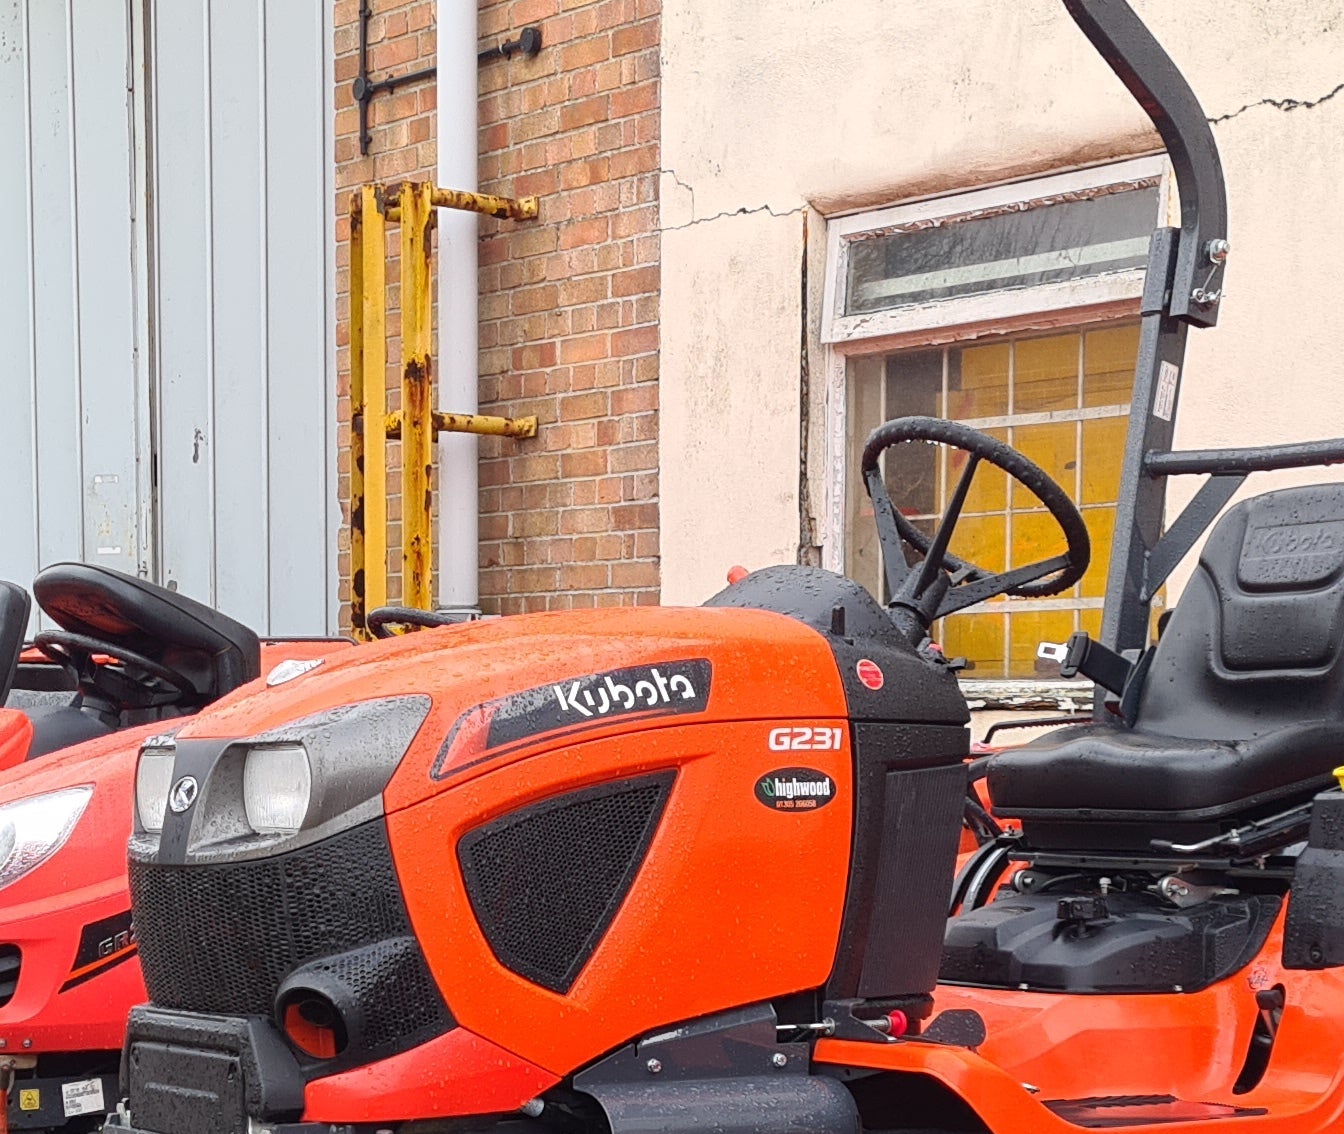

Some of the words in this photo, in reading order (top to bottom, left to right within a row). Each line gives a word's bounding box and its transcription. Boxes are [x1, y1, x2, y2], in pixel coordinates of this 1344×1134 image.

[553, 668, 696, 717] Kubota
[768, 727, 843, 751] G231
[774, 777, 831, 798] highwood
[98, 921, 136, 958] GR
